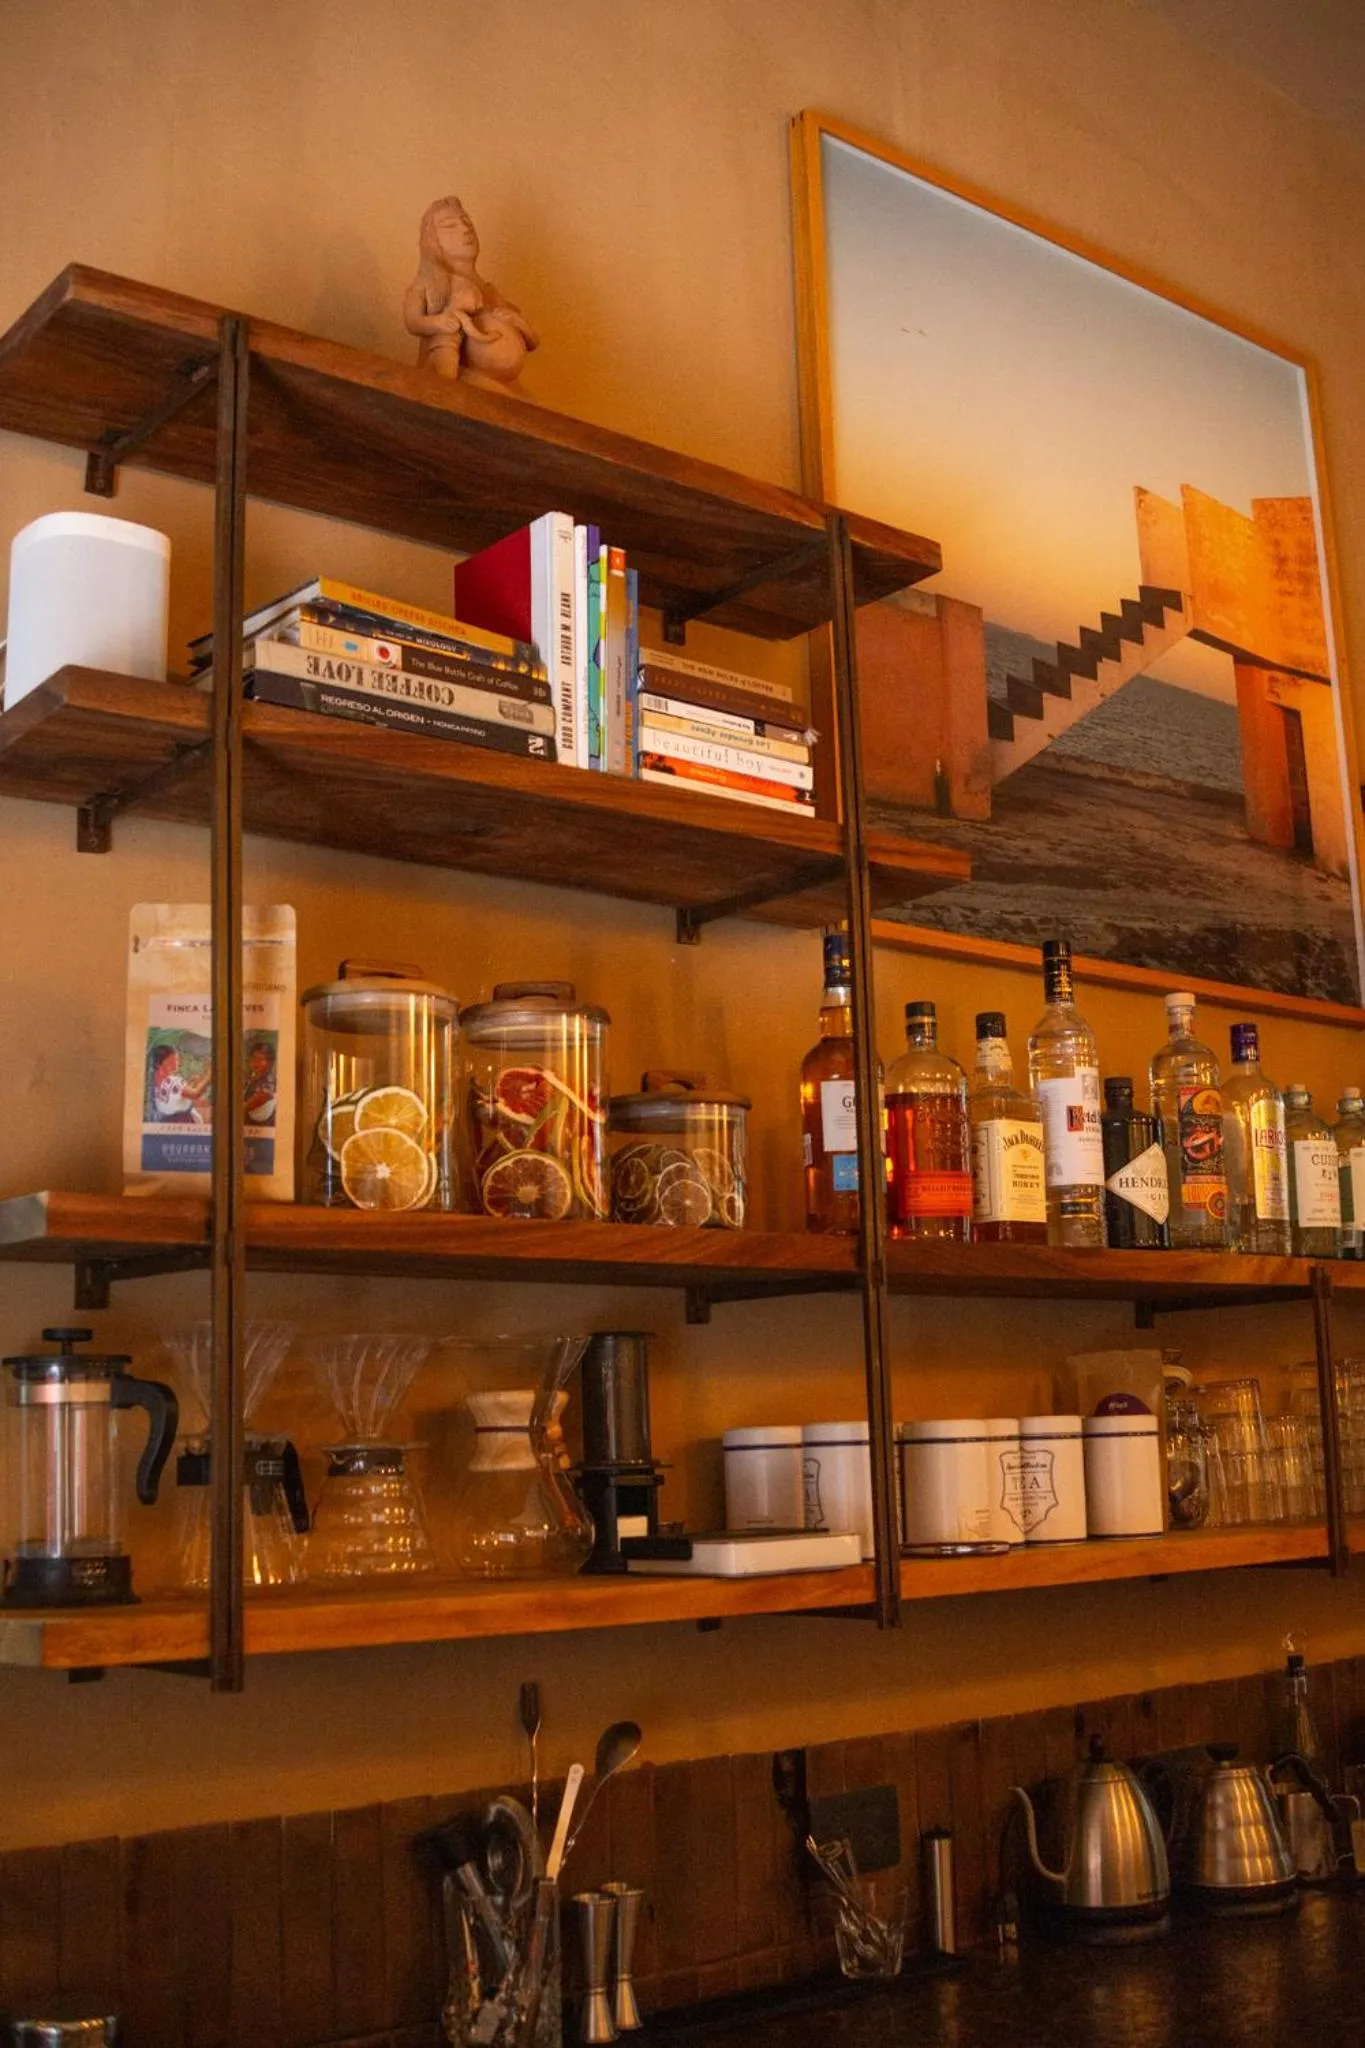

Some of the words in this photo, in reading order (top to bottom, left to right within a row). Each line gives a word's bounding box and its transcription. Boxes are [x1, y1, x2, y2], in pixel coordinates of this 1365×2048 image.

[560, 592, 571, 618] BLANK
[416, 637, 456, 652] MIXOLOGY
[560, 634, 572, 666] ARTHUR
[306, 654, 364, 687] LOVE
[411, 656, 426, 669] The
[427, 660, 443, 673] Blue
[444, 665, 466, 678] Bottle
[467, 671, 486, 683] Craft
[486, 674, 495, 684] of
[495, 679, 519, 692] Coffee
[716, 670, 740, 685] RULES
[749, 680, 774, 693] COFFEE
[370, 669, 455, 707] COFFEE
[320, 693, 371, 712] REGRESO
[372, 705, 386, 716] AL
[386, 708, 424, 724] ORIGEN
[561, 680, 573, 724] COMPANY
[561, 725, 573, 750] GOOD
[652, 732, 730, 763] beautiful
[736, 752, 764, 773] boy
[166, 1003, 200, 1013] FINCA
[1002, 1133, 1021, 1152] JACK
[1012, 1180, 1040, 1189] HONEY
[1011, 1475, 1042, 1491] TEA
